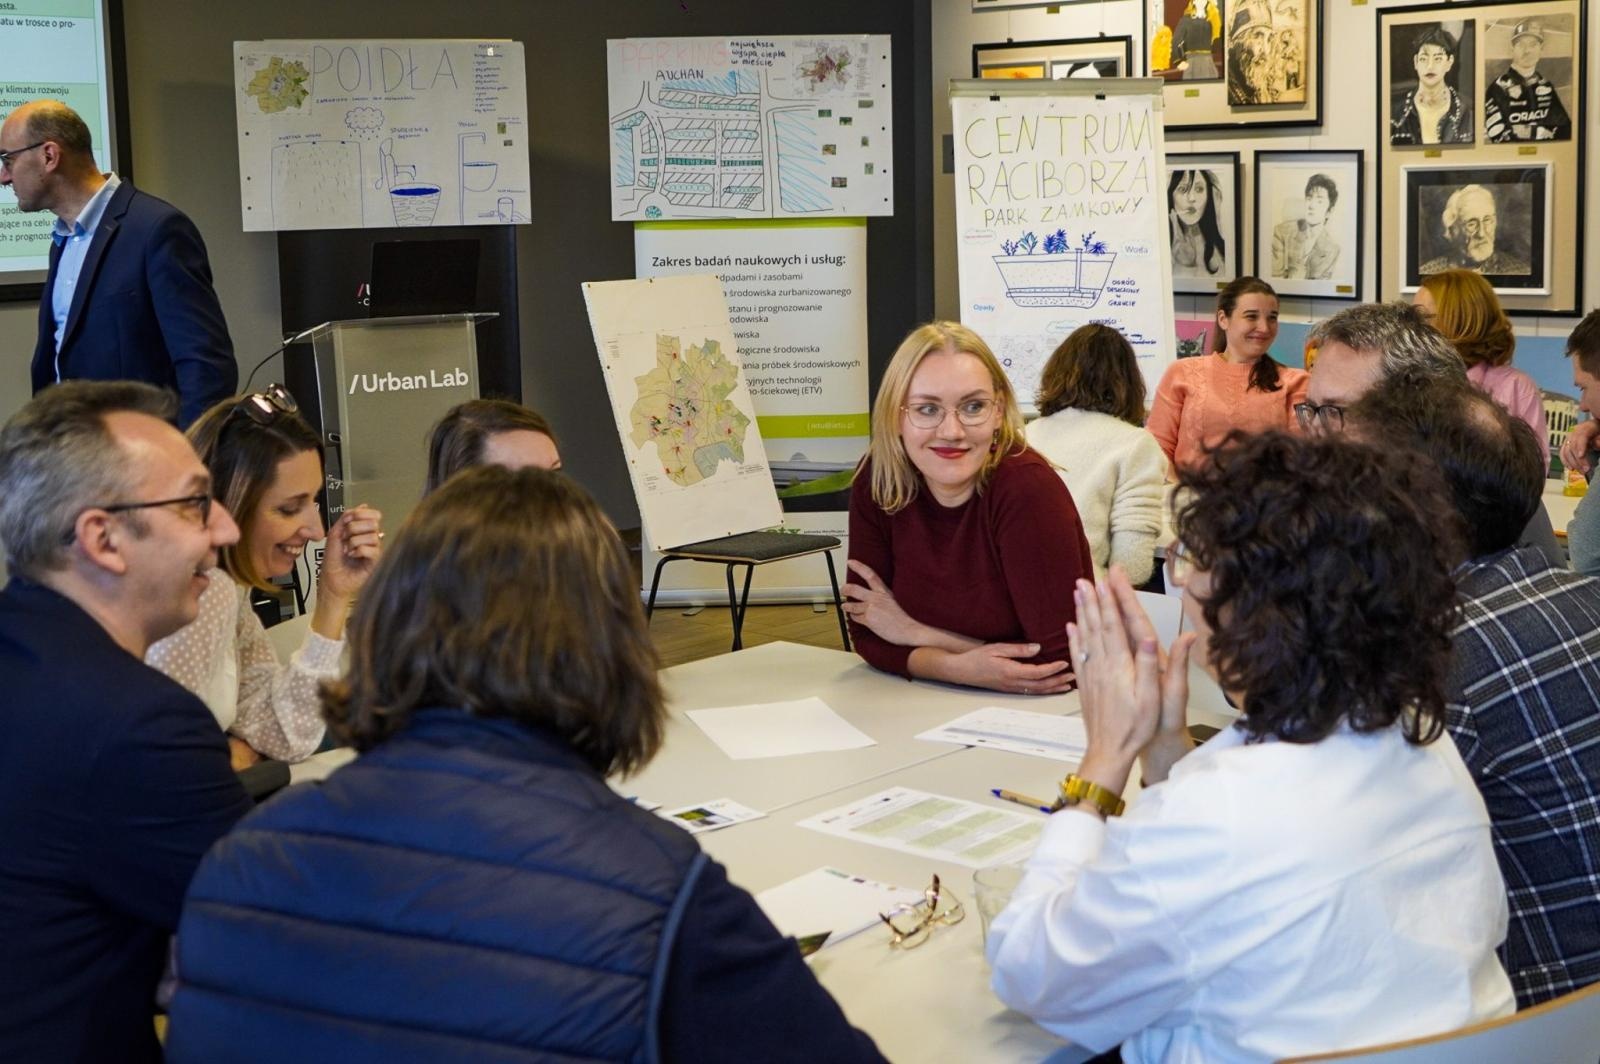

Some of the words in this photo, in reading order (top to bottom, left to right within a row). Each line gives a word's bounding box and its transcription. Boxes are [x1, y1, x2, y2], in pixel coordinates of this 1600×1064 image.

[25, 18, 50, 27] trosce
[59, 20, 76, 29] pro-
[312, 45, 458, 96] POIDŁA
[656, 69, 704, 81] AUCHAN
[6, 85, 36, 94] klimatu
[38, 86, 69, 95] rozwoju
[965, 108, 1152, 158] CENTRUM
[967, 156, 1149, 206] RACIBORZA
[985, 207, 1029, 228] PARK
[1040, 197, 1143, 223] ZAMKOWY
[34, 218, 51, 227] celu
[652, 256, 692, 268] Zakres
[694, 255, 732, 267] badań
[735, 254, 802, 268] naukowych
[811, 254, 847, 267] usług:
[763, 273, 803, 281] zasobami
[729, 288, 777, 297] środowiska
[778, 287, 852, 298] zurbanizowanego
[728, 304, 752, 313] stanu
[758, 303, 823, 314] prognozowanie
[736, 345, 771, 356] logiczne
[773, 345, 820, 354] środowiska
[761, 360, 791, 371] próbek
[793, 359, 861, 370] środowiskowych
[430, 367, 469, 388] Lab
[776, 375, 822, 386] technologii
[801, 386, 823, 396] (ETV)
